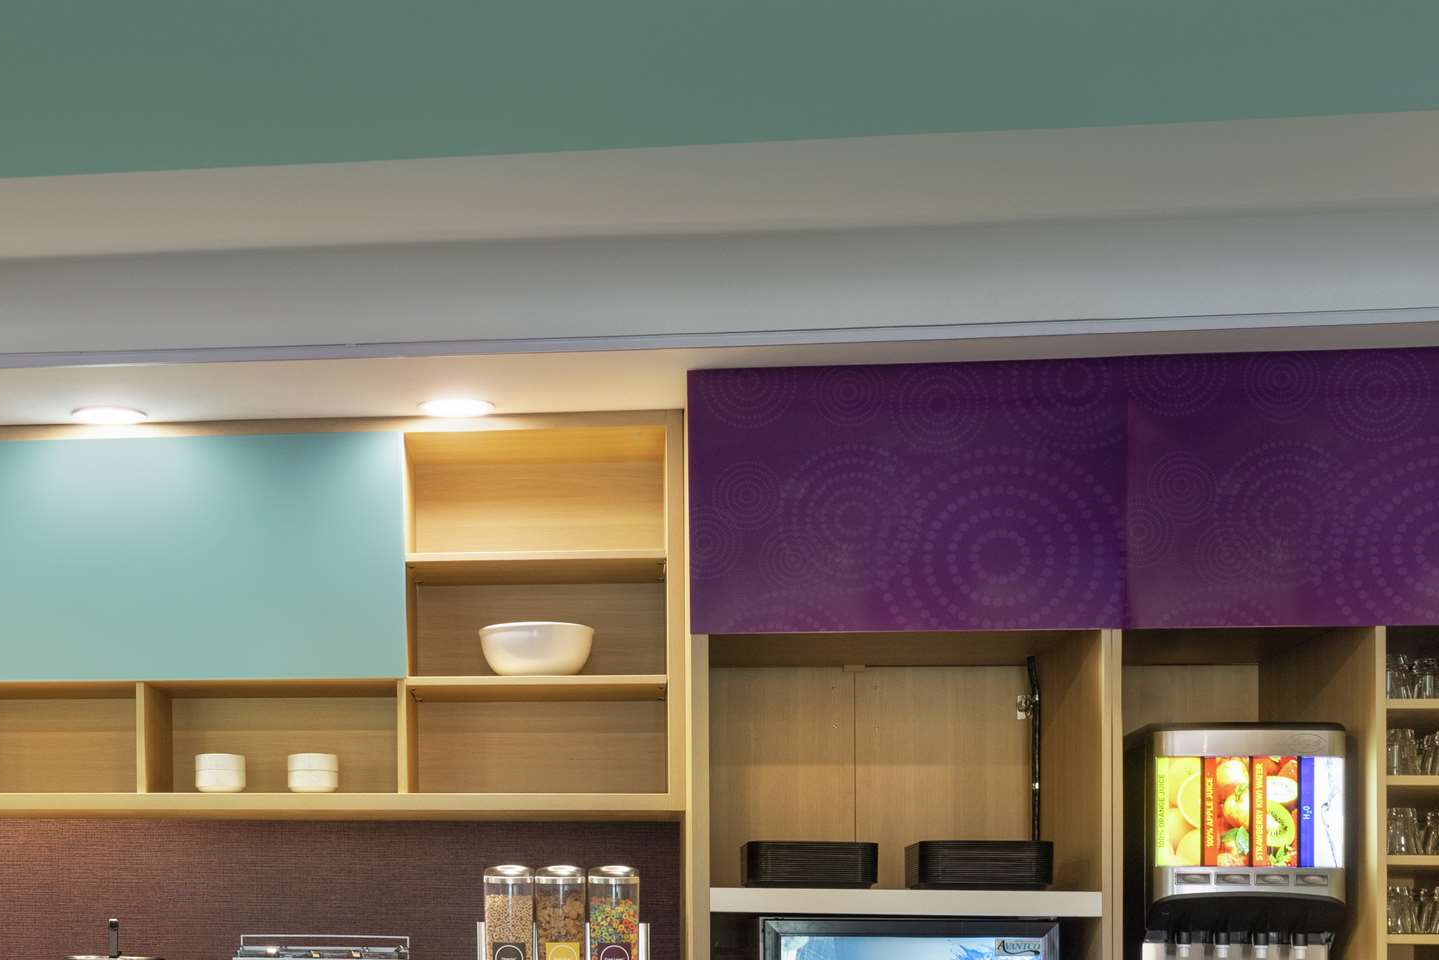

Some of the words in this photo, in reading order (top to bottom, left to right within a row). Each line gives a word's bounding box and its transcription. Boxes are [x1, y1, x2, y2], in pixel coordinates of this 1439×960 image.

[1158, 774, 1166, 796] JUICE
[1255, 763, 1264, 788] WATER
[1206, 777, 1214, 799] JUICE
[1255, 790, 1264, 808] KIWI
[1158, 797, 1166, 828] ORANGE
[1206, 800, 1214, 827] APPLE
[1206, 828, 1214, 848] 100%
[1255, 809, 1264, 861] STRAWBERRY
